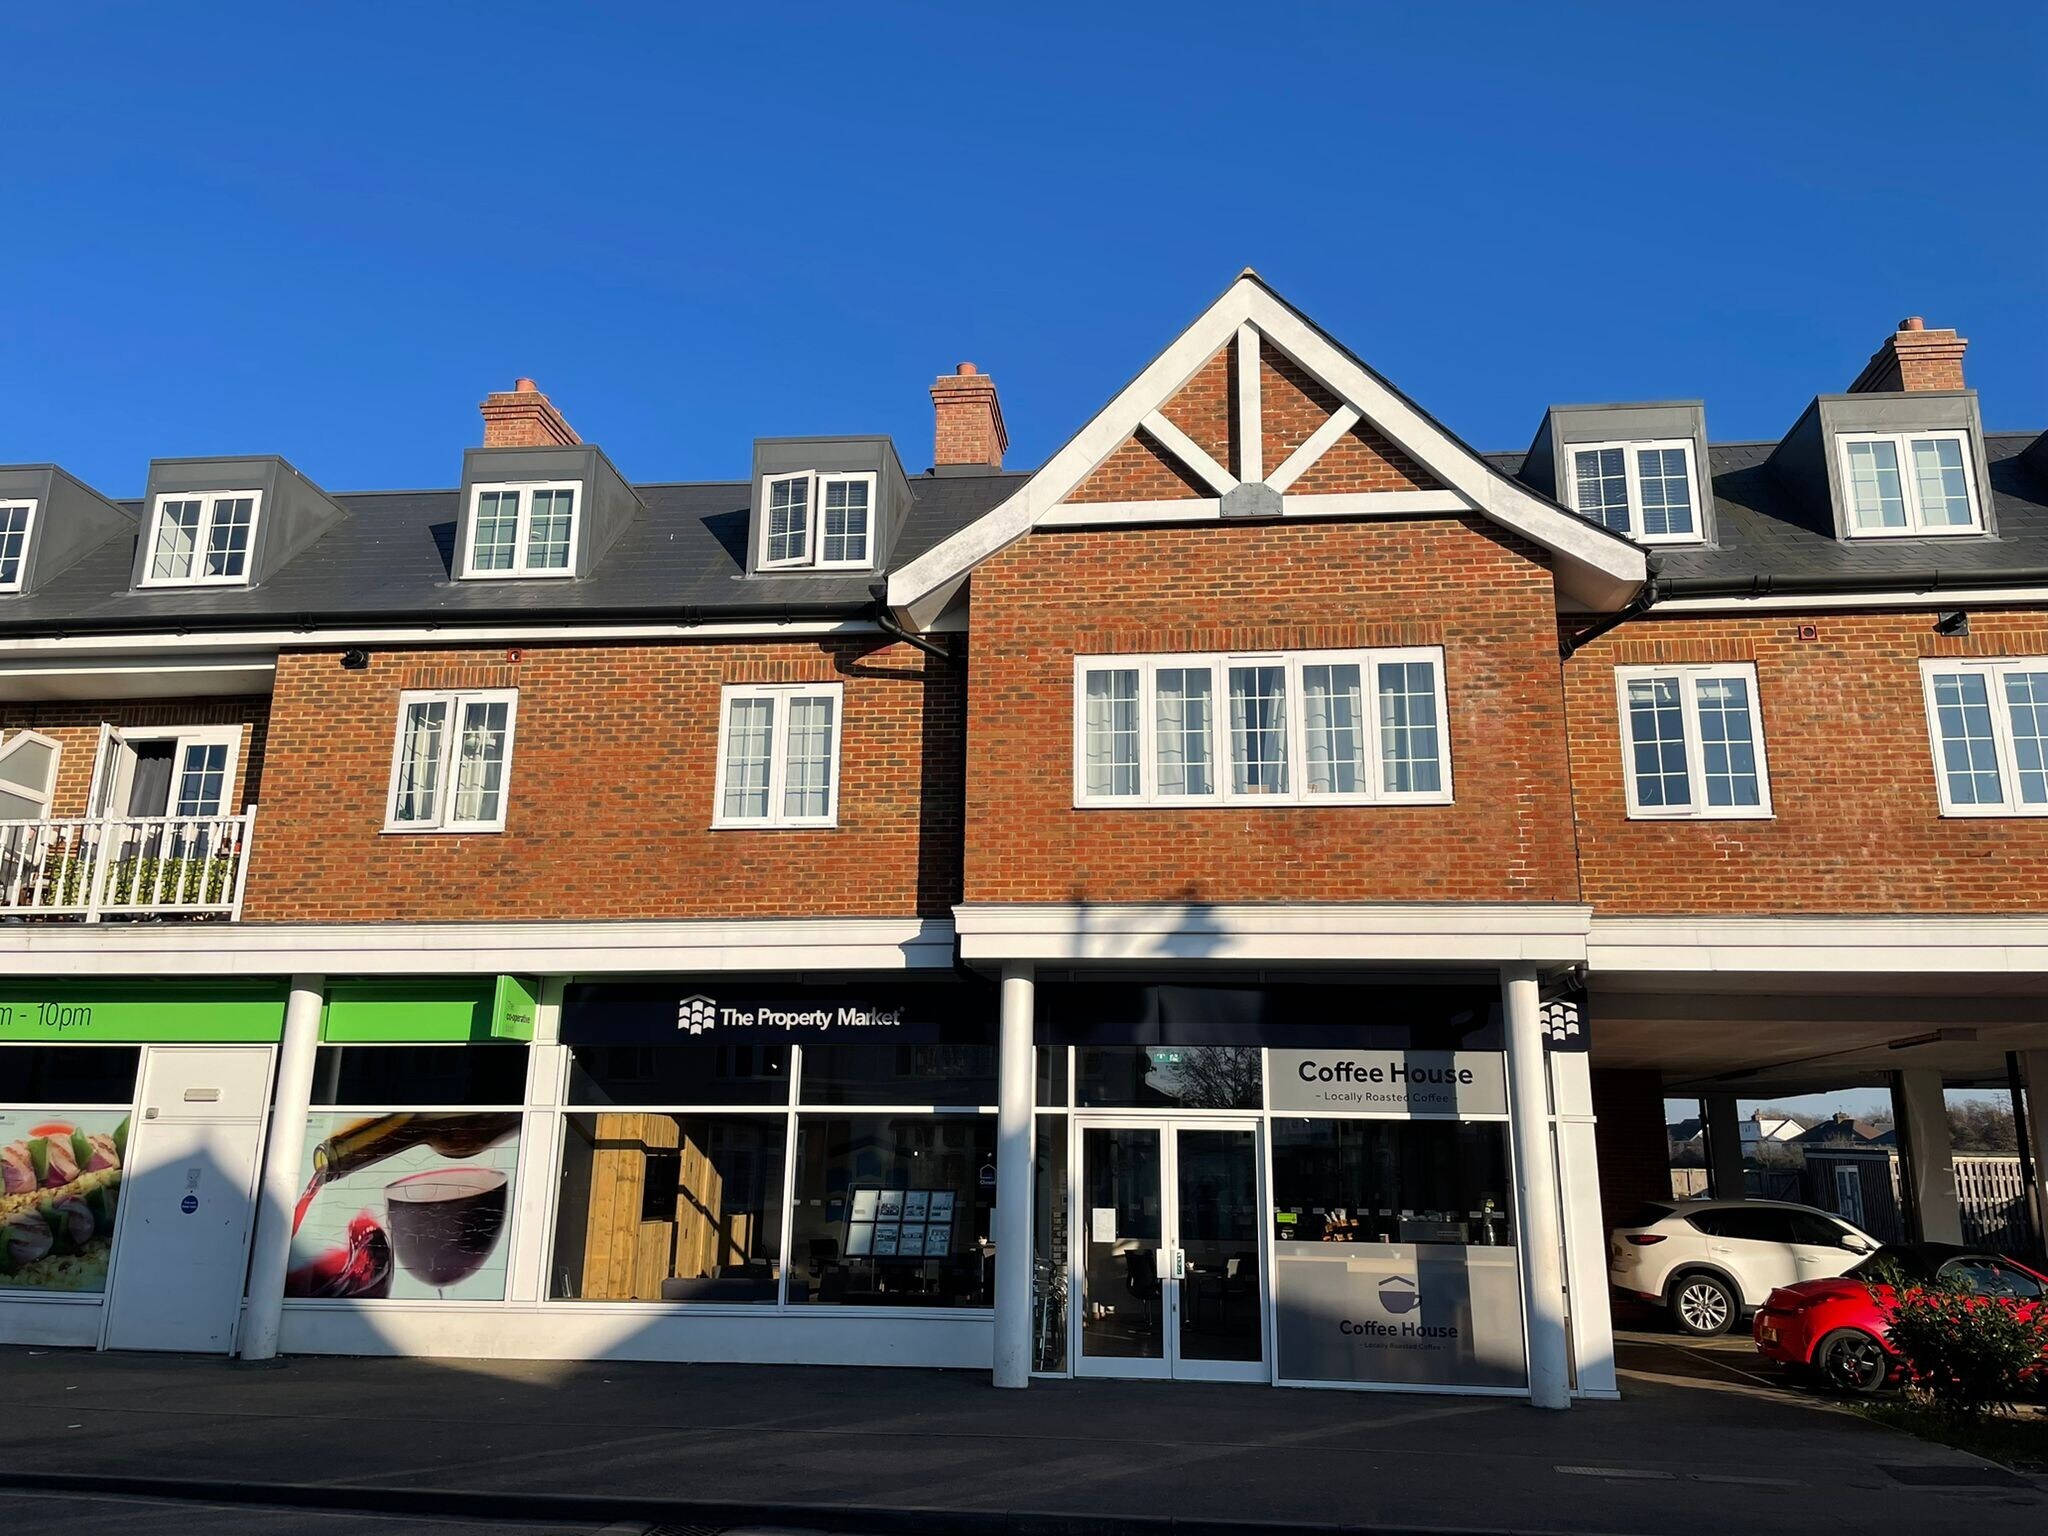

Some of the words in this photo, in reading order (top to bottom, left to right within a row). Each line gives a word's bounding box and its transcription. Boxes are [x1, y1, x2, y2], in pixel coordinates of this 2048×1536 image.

[37, 1001, 92, 1032] 10pm
[720, 1007, 755, 1026] The
[757, 1007, 833, 1031] Property
[1298, 1060, 1384, 1083] Coffee
[1390, 1062, 1474, 1085] House
[1324, 1091, 1363, 1104] Locally
[1365, 1092, 1410, 1103] Roasted
[1412, 1093, 1449, 1104] Coffee
[1339, 1319, 1398, 1337] Coffee
[1401, 1321, 1458, 1339] House
